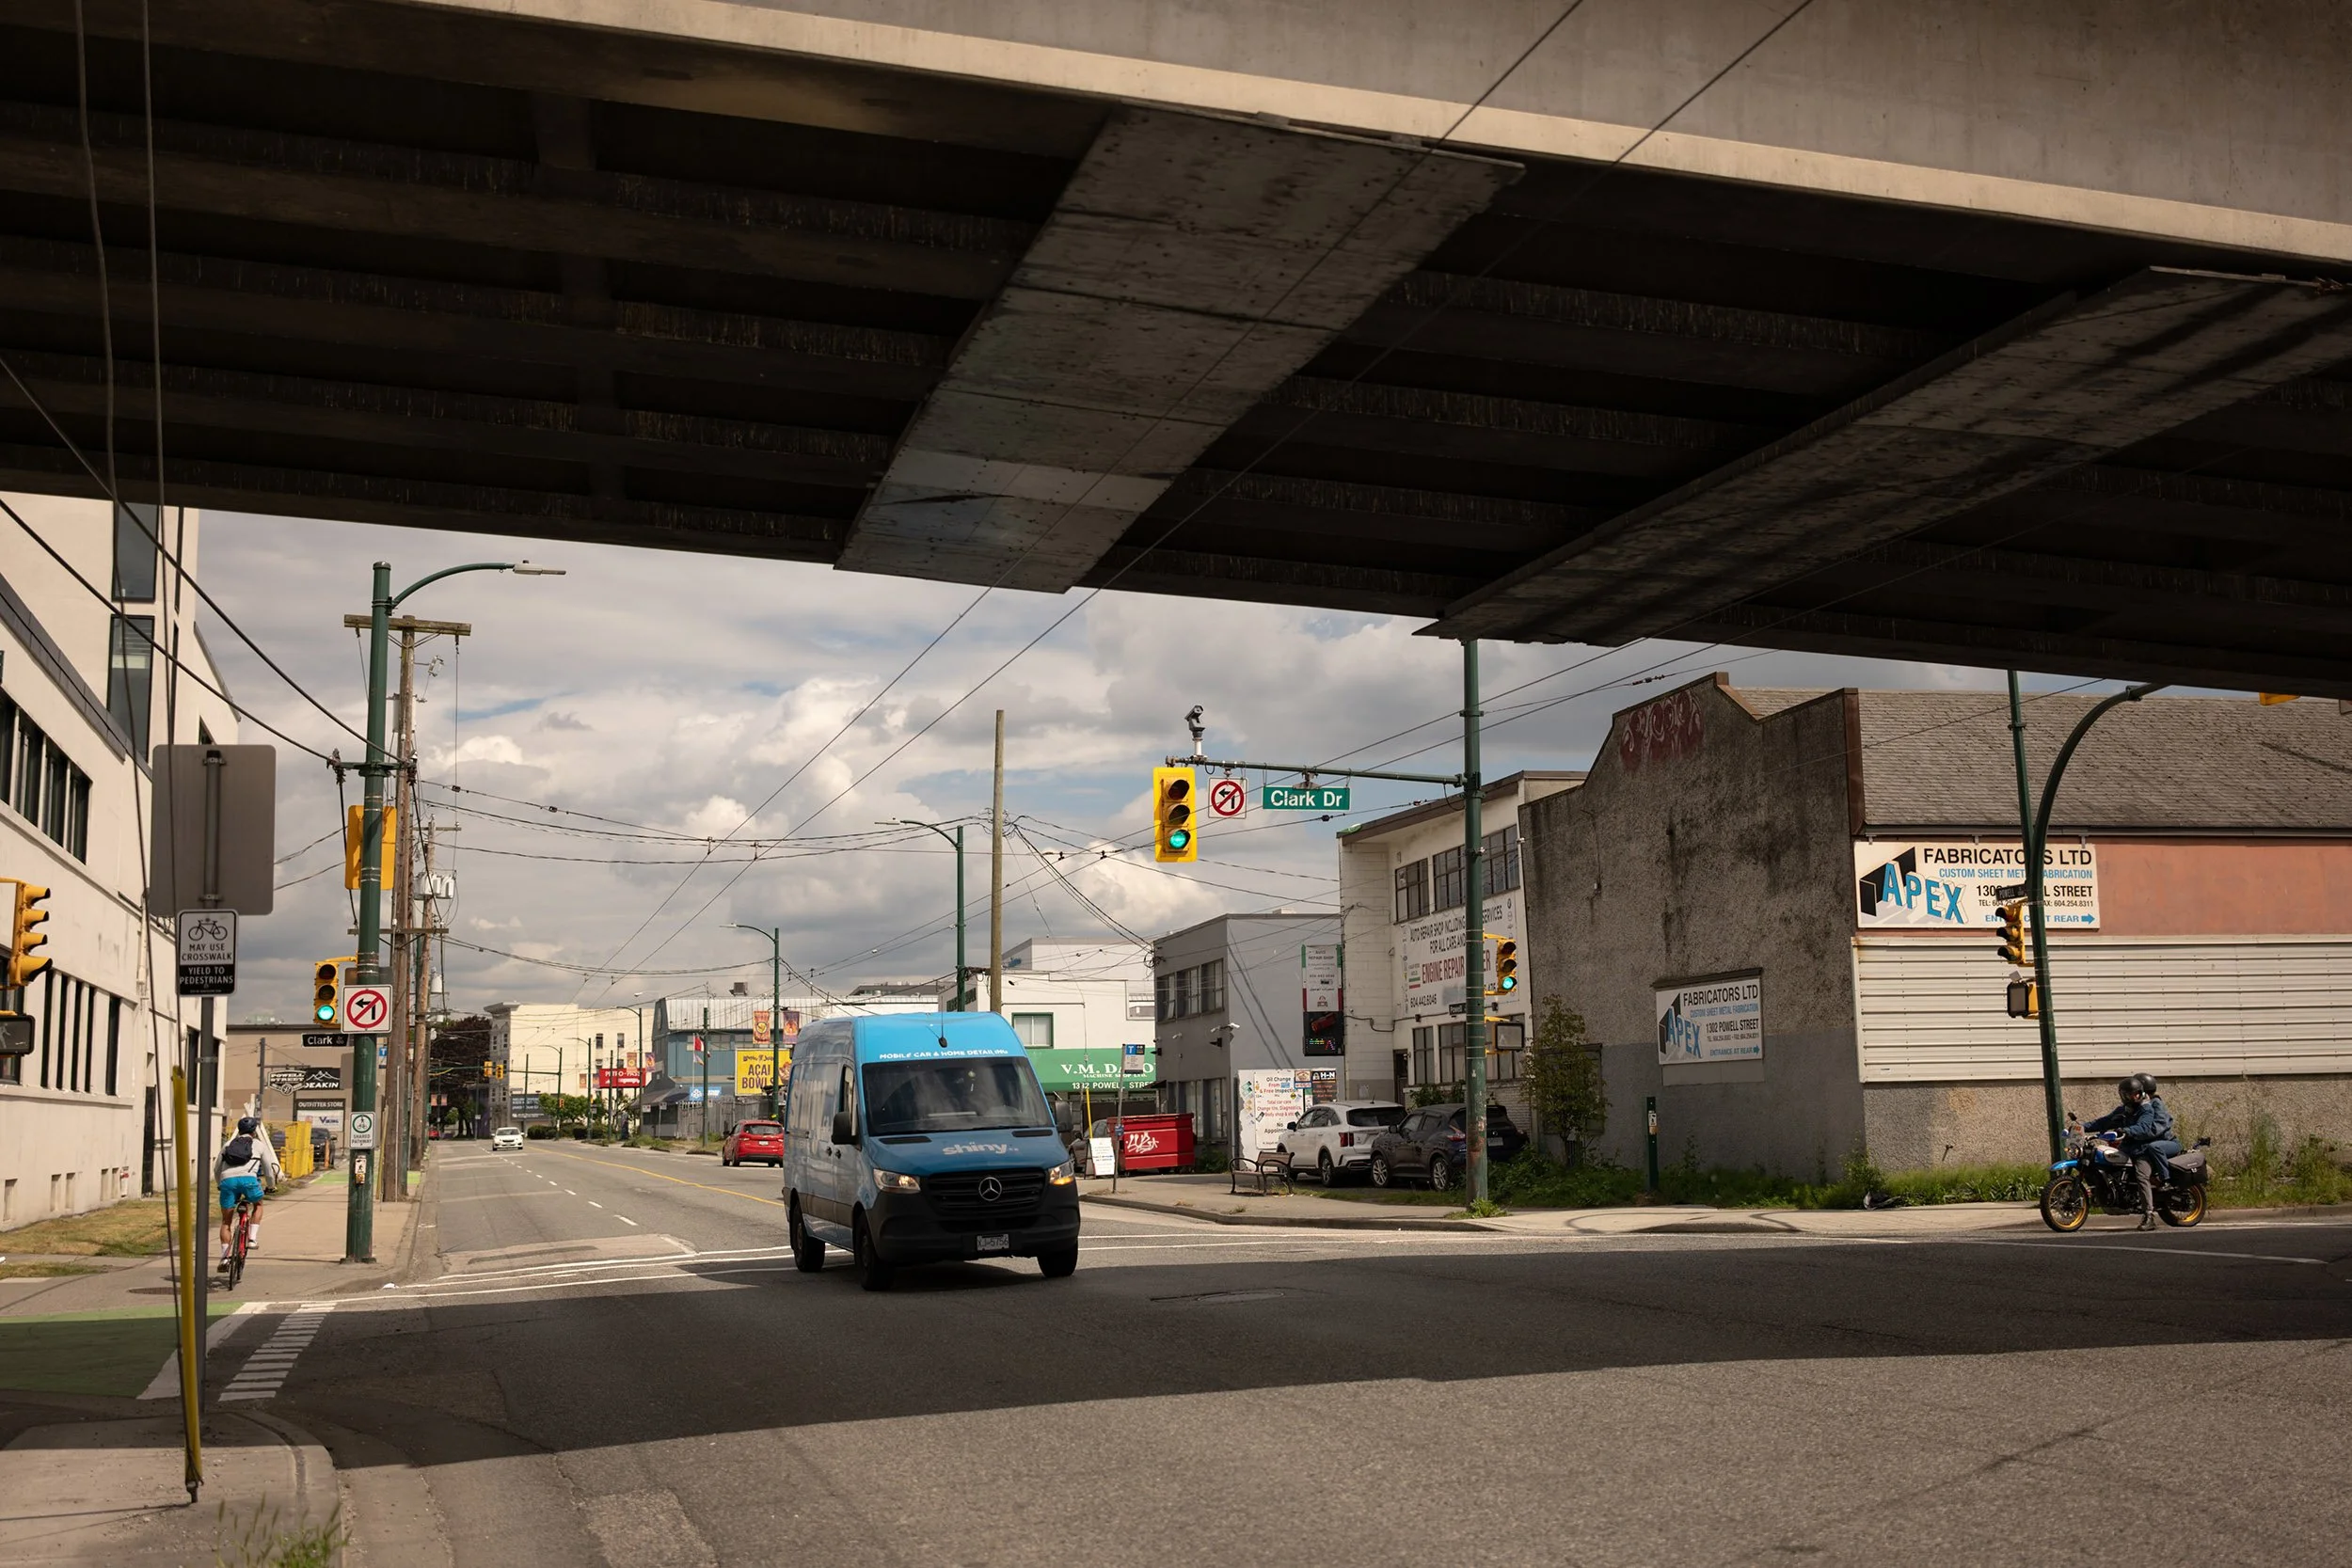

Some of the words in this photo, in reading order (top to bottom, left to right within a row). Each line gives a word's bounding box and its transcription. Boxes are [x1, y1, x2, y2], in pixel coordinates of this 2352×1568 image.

[1270, 789, 1315, 807] Clark
[1323, 790, 1343, 807] Dr
[1924, 848, 2054, 864] FABRICATOS
[2059, 849, 2091, 865] LTD
[1939, 868, 1975, 878] CUSTOM
[1978, 868, 2004, 878] SHEET
[2007, 869, 2027, 879] MET
[2042, 870, 2092, 879] ABRICATION
[1882, 862, 1966, 925] APEX
[2053, 886, 2093, 897] STREET
[1420, 923, 1434, 941] REPAIR
[1434, 920, 1444, 938] SHOP
[188, 942, 206, 952] MAY
[210, 942, 226, 951] USE
[1430, 940, 1438, 954] FOR
[1438, 936, 1447, 952] ALL
[1447, 933, 1458, 950] CARS
[181, 953, 232, 961] CROSSWALK
[188, 966, 211, 975] YIELD
[215, 966, 225, 974] TO
[1422, 960, 1442, 984] ENGINE
[1443, 955, 1465, 979] REPAIR
[179, 975, 233, 985] PEDESTRIANS
[1683, 986, 1740, 1006] FABRICATORS
[1741, 984, 1758, 1000] LTD
[1667, 1008, 1702, 1059] APEX
[1706, 1022, 1718, 1034] 1302
[1719, 1020, 1739, 1033] POWELL
[1740, 1019, 1759, 1031] STREET
[307, 1036, 333, 1045] Clark
